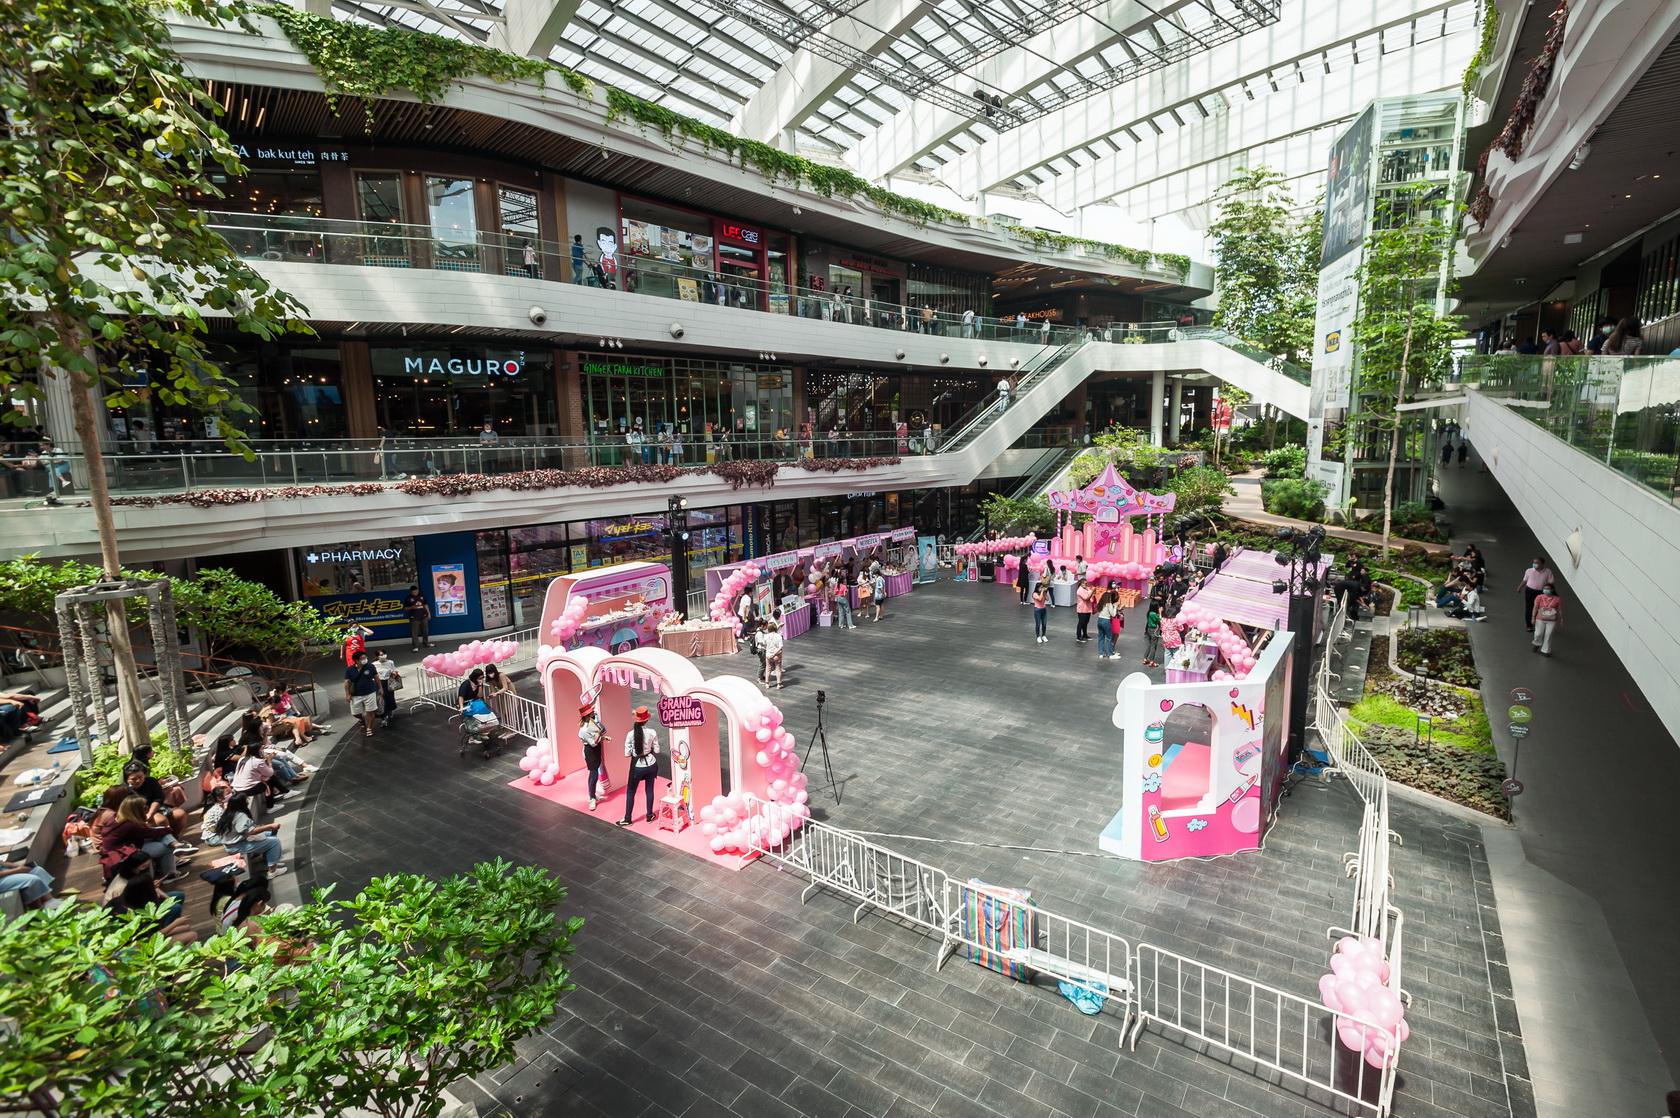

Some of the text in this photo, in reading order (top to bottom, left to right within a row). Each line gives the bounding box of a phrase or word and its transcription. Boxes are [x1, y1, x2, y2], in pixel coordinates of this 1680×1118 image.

[257, 149, 277, 159] bak
[278, 149, 296, 160] kut
[297, 150, 315, 160] teh
[723, 224, 743, 240] LEE
[1326, 337, 1339, 348] IKEA
[404, 357, 520, 376] MAGURO
[583, 362, 663, 377] GINGER FARM KITCHEN
[321, 548, 403, 563] PHARMACY
[572, 549, 585, 557] TAX
[780, 556, 794, 564] SKIN
[322, 598, 404, 618] マツモトキヨシ
[659, 695, 692, 710] GRAND
[662, 708, 702, 721] OPENING
